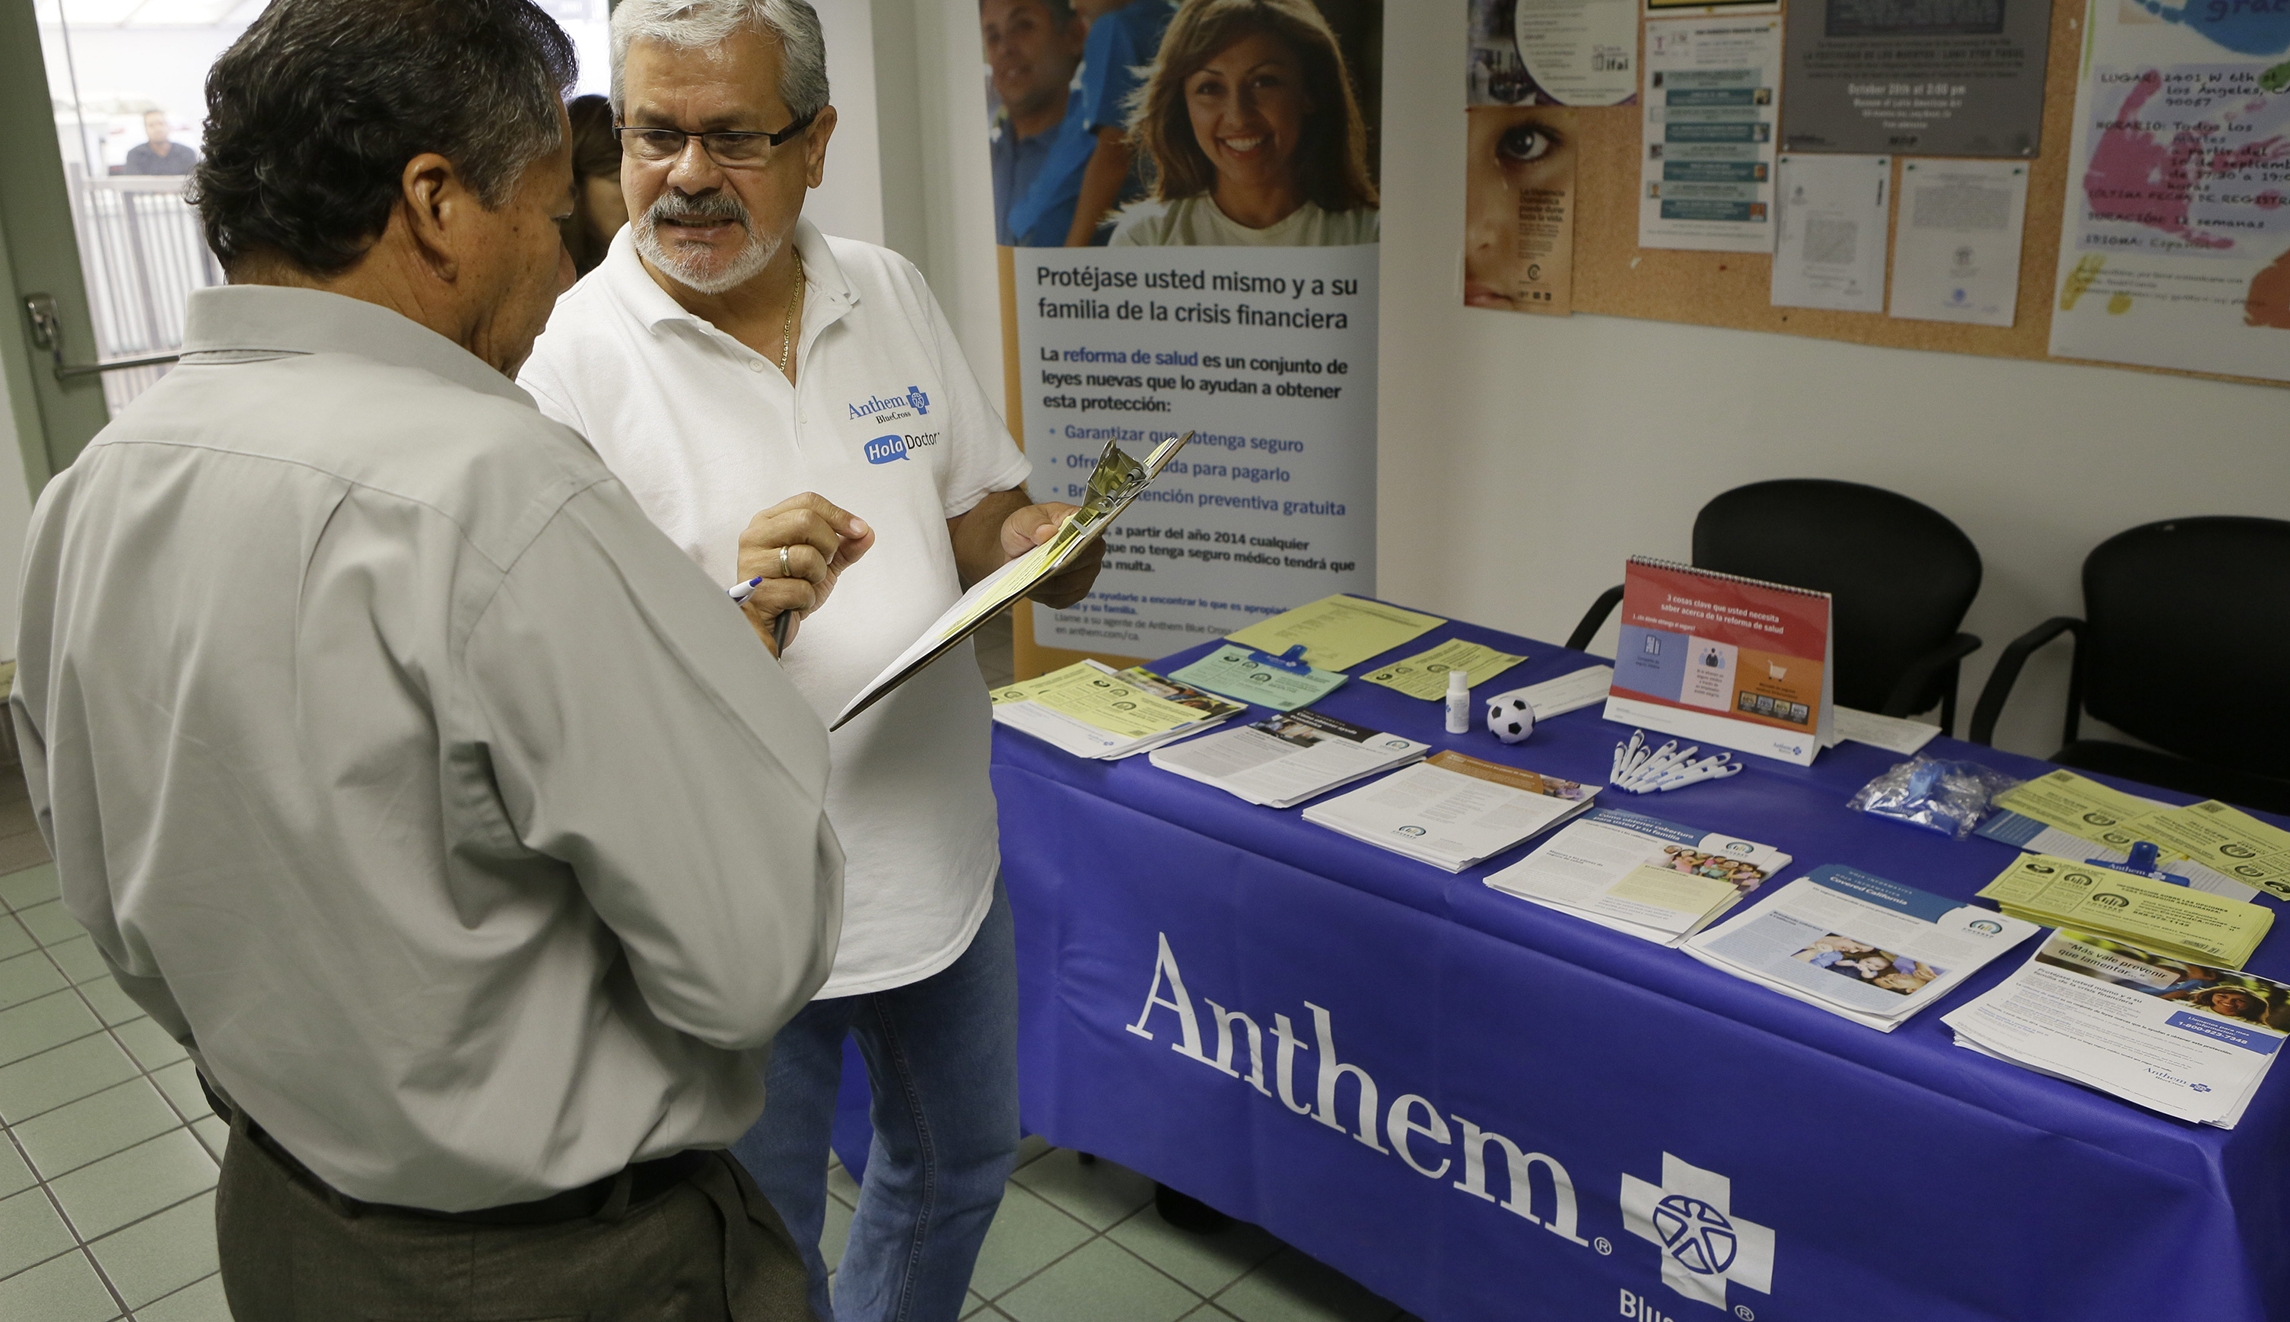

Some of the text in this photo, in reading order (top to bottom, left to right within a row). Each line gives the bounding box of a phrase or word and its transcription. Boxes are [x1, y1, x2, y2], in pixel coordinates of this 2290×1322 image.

[1606, 57, 1629, 71] ifai
[2209, 73, 2222, 82] W
[2262, 171, 2290, 183] 19:0
[2197, 217, 2265, 229] semanas
[1037, 266, 1359, 299] Protéjase usted mismo y a su
[1038, 297, 1348, 330] familia de la crisis financiera
[1041, 346, 1348, 377] La reforma de salud es un conjunto de
[1042, 370, 1342, 400] leyes nuevas que lo ayudan a obtener
[848, 395, 906, 420] Anthem
[1043, 393, 1172, 413] esta protección:
[875, 411, 911, 424] BlueCross
[1065, 425, 1146, 442] Garantizar
[1250, 436, 1304, 454] seguro
[1193, 463, 1228, 480] para
[1231, 464, 1290, 484] pagarlo
[1199, 491, 1280, 512] preventiva
[1283, 498, 1347, 516] gratuita
[1115, 526, 1311, 553] a partir del año 2014 cualquier
[1116, 559, 1156, 573] multa.
[1130, 544, 1146, 556] no
[1149, 544, 1186, 559] tenga
[1188, 547, 1232, 563] seguro
[1234, 549, 1281, 567] médico
[1284, 554, 1328, 572] tendrá
[1330, 560, 1357, 575] que
[1198, 598, 1209, 608] lo
[1210, 600, 1228, 611] que
[1230, 602, 1242, 612] es
[1244, 603, 1291, 616] apropiad
[1667, 594, 1672, 602] 3
[1673, 596, 1693, 606] cosas
[1694, 598, 1711, 610] clave
[1713, 602, 1726, 613] que
[1728, 605, 1748, 617] usted
[1661, 603, 1680, 614] saber
[1706, 611, 1715, 620] de
[1717, 613, 1723, 622] la
[1764, 622, 1784, 635] salud
[1613, 819, 1636, 830] usted
[1654, 822, 1695, 839] cobertura
[2108, 863, 2146, 877] Anthem
[1829, 875, 1909, 906] Covered California
[2058, 949, 2079, 960] que
[2096, 952, 2119, 964] vale
[2119, 961, 2169, 980] prevenir
[2143, 1066, 2187, 1085] Anthem
[1125, 931, 1590, 1248] Anthem
[1619, 1287, 1675, 1322] Blu
